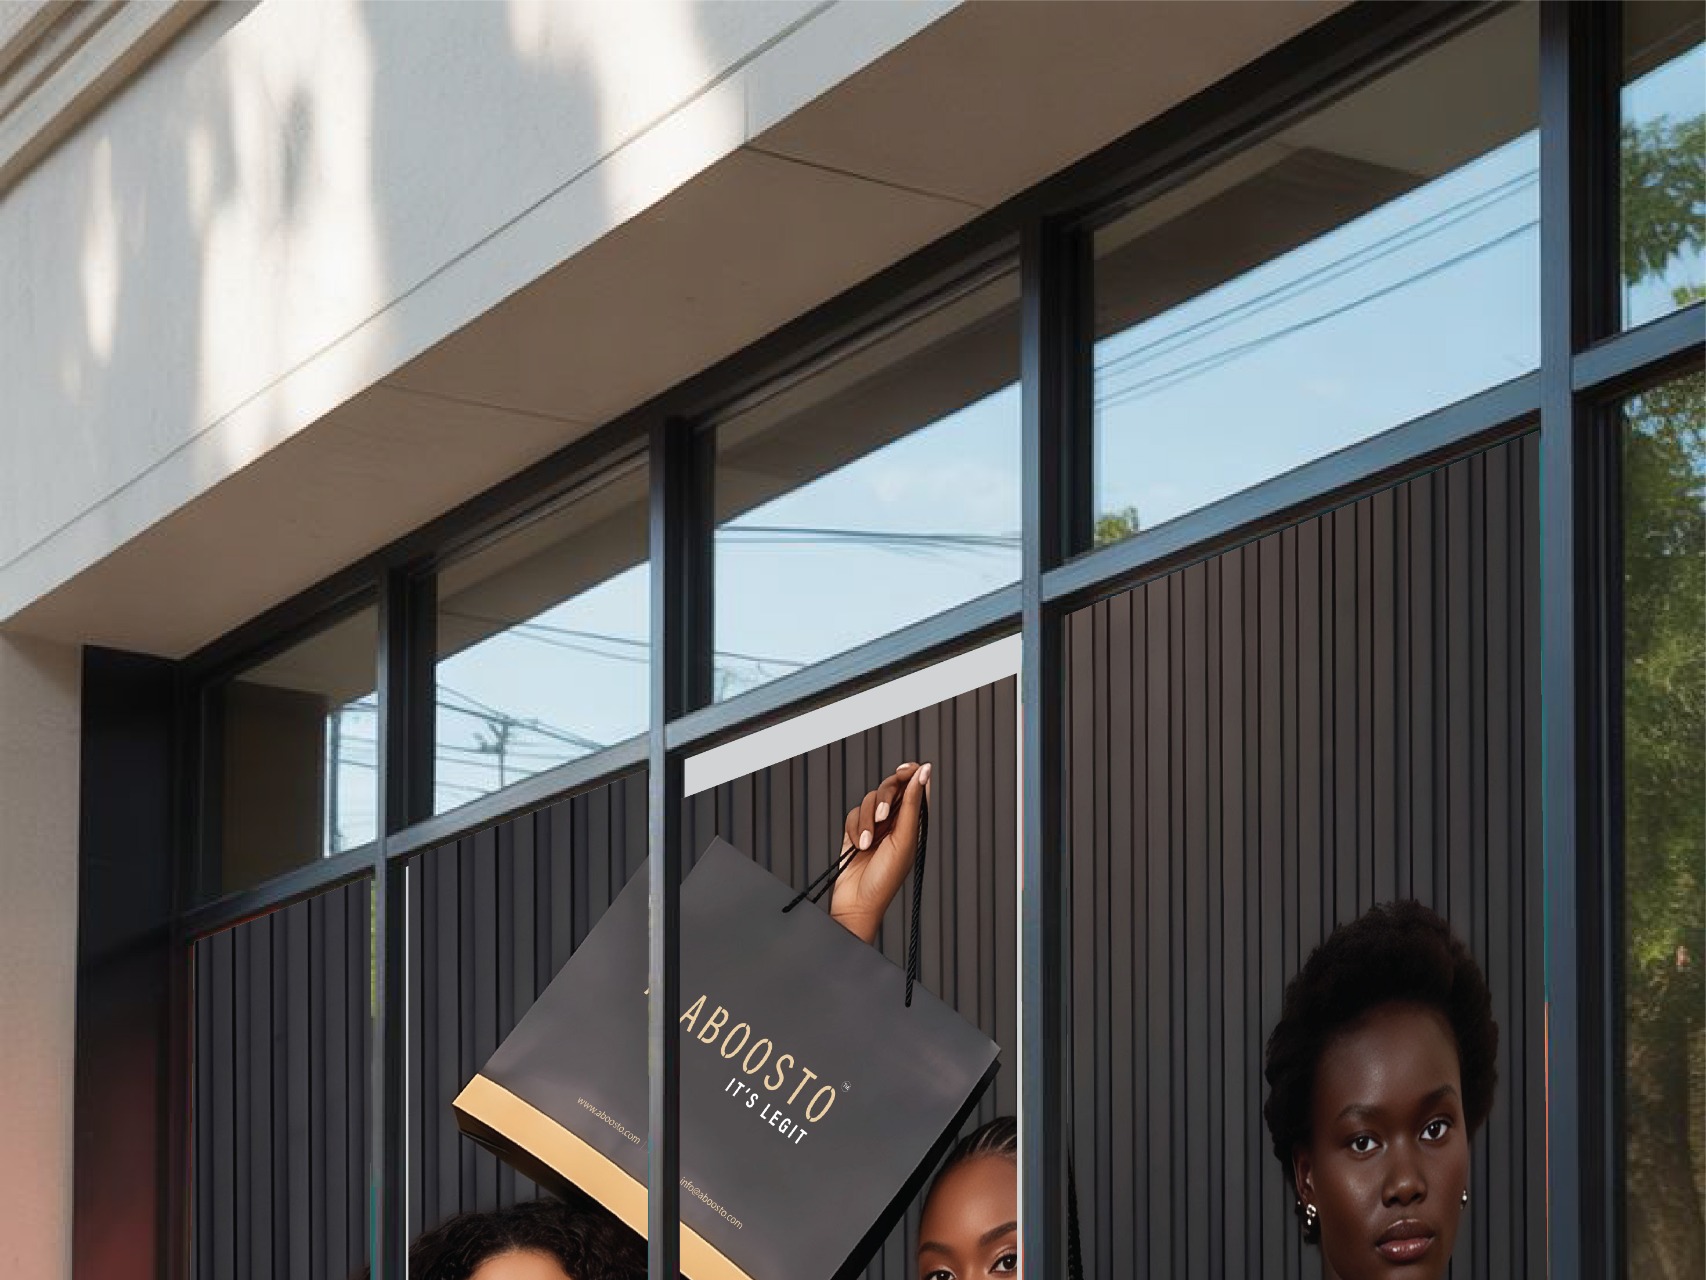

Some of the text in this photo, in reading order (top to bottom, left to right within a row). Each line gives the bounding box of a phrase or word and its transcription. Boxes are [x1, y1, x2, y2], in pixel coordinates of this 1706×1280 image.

[680, 995, 836, 1122] ABOOSTO
[577, 1097, 641, 1144] www.aboosto.com
[725, 1078, 808, 1144] IT'S LEGIT
[680, 1176, 743, 1229] info@aboosto.com
